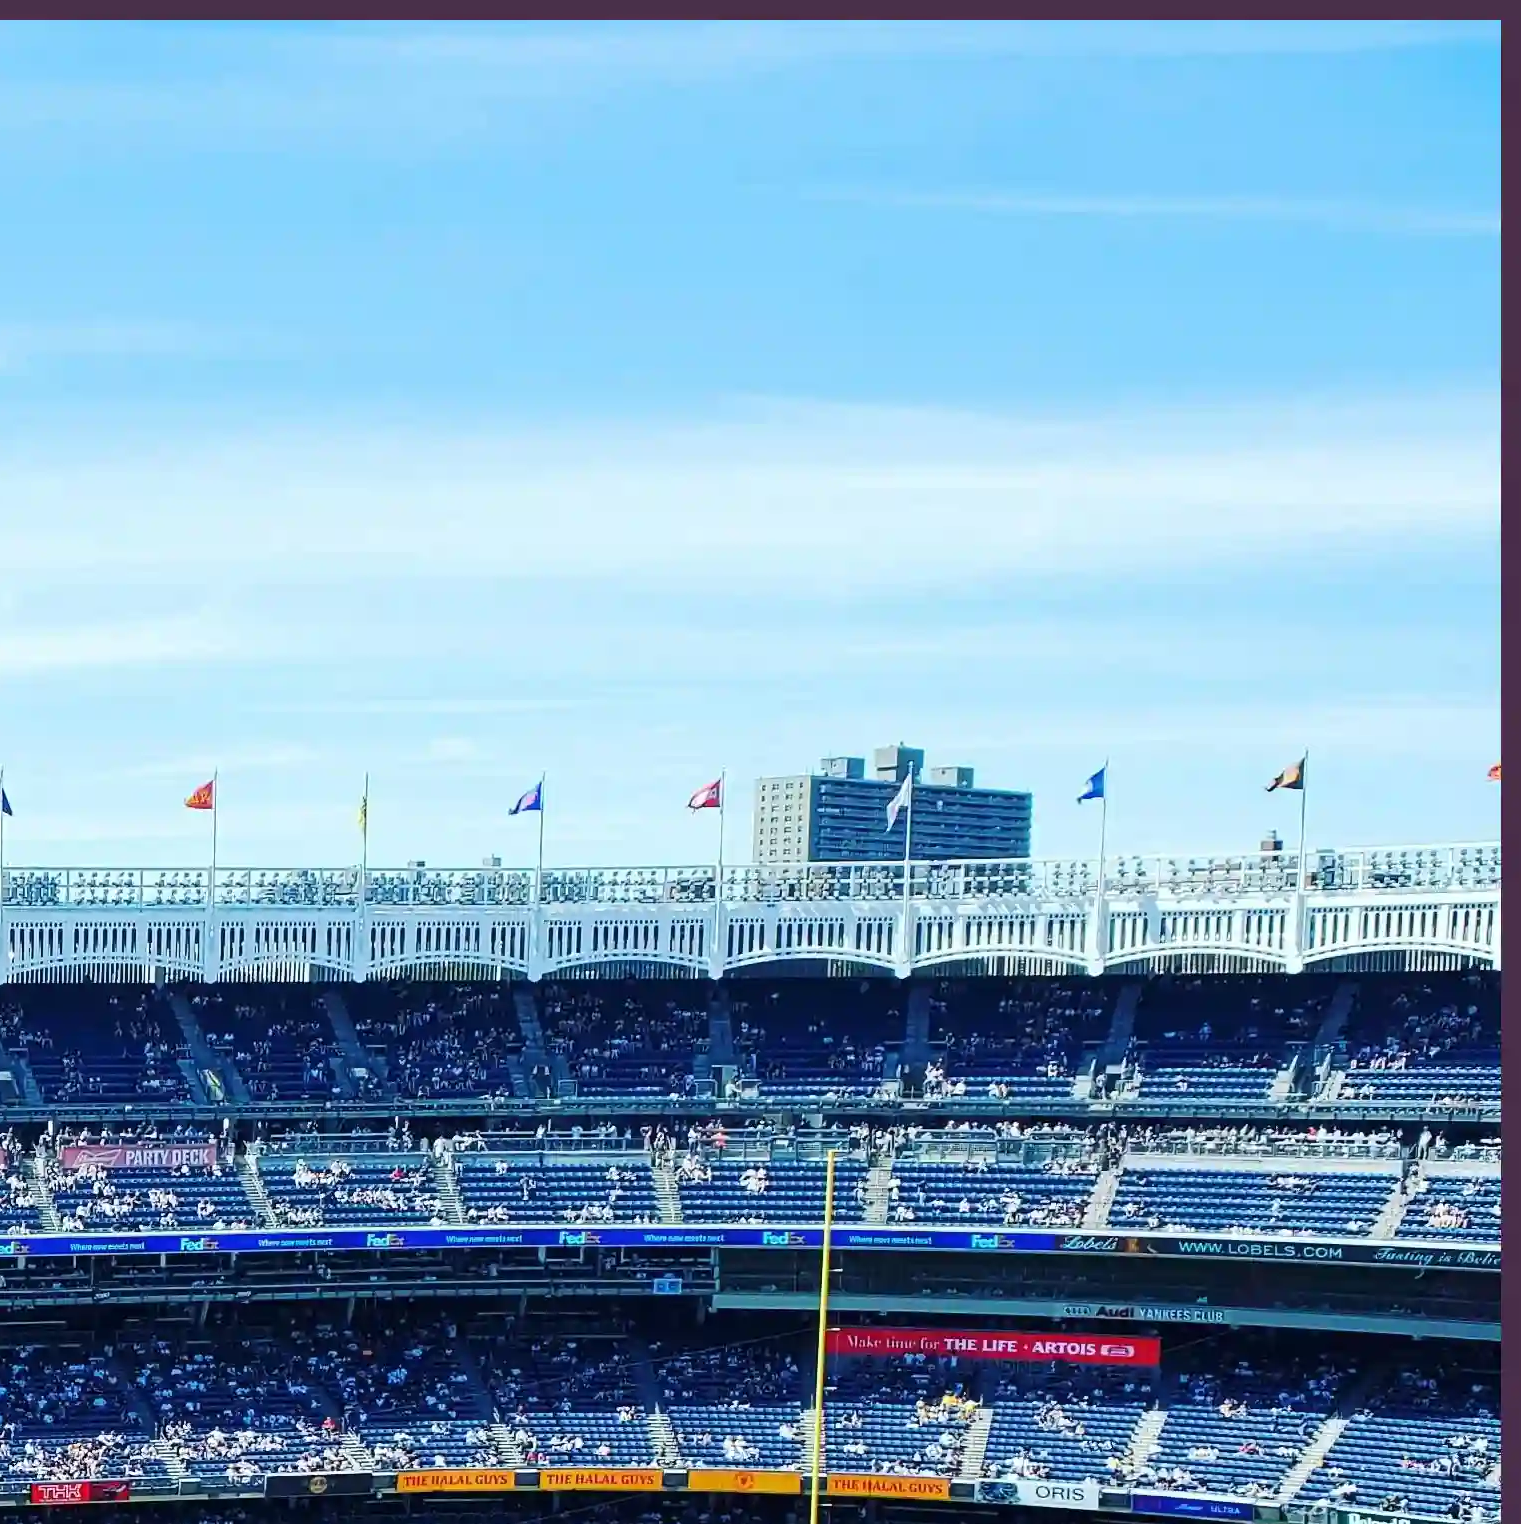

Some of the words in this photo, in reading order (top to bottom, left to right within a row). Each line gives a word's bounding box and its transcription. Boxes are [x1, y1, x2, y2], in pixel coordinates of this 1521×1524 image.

[125, 1149, 168, 1166] PARTY
[171, 1148, 208, 1166] DECK
[180, 1238, 219, 1251] FedEx
[367, 1233, 406, 1247] FedEx
[559, 1231, 601, 1244] FedEx
[763, 1231, 805, 1245] FedEx
[971, 1234, 1015, 1249] FedEx
[1095, 1306, 1134, 1319] Audi
[1139, 1308, 1191, 1321] YANKEES
[1194, 1309, 1224, 1323] CLUB
[847, 1334, 881, 1349] Make
[886, 1336, 915, 1349] time
[920, 1336, 939, 1350] for
[944, 1337, 977, 1351] THE
[982, 1339, 1018, 1353] LIFE
[1032, 1341, 1096, 1356] ARTOIS
[403, 1475, 427, 1487] THE
[431, 1475, 472, 1486] HALAL
[475, 1473, 508, 1485] GUYS
[547, 1474, 572, 1485] THE
[575, 1474, 617, 1485] HALAL
[621, 1474, 655, 1485] GUYS
[833, 1479, 859, 1491] THE
[862, 1480, 907, 1492] HALAL
[909, 1481, 943, 1494] GUYS
[38, 1484, 83, 1499] THK
[1035, 1485, 1085, 1501] ORIS
